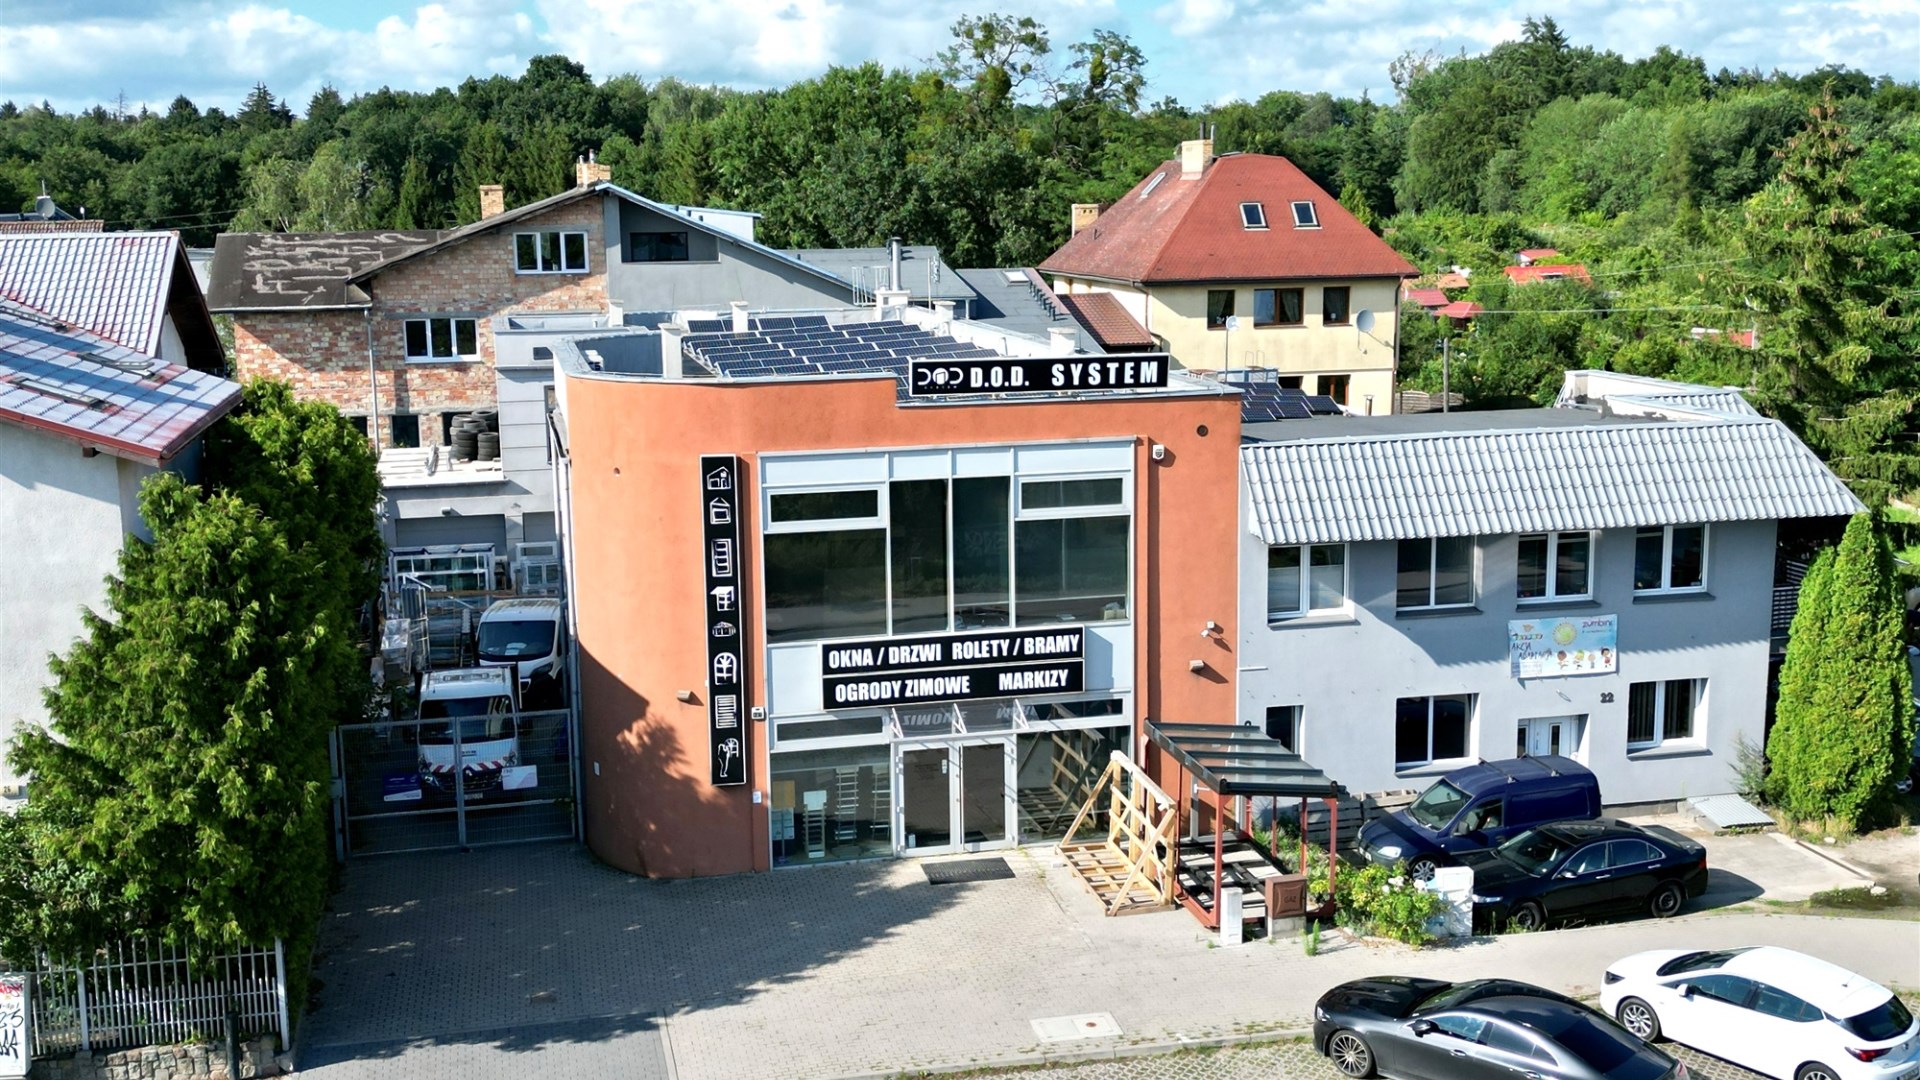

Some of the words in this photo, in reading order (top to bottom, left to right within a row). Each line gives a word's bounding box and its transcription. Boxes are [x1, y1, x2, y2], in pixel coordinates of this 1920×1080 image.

[970, 366, 1030, 388] D.O.D.
[1051, 361, 1158, 386] SYSTEM
[828, 648, 873, 669] OKNA
[888, 643, 941, 664] DRZWI
[952, 638, 1010, 660] ROLETY
[1024, 634, 1079, 655] BRAMY
[835, 680, 901, 702] OGRODY
[904, 675, 971, 697] ZIMOWE
[999, 669, 1069, 691] MARKIZY
[1600, 692, 1614, 703] 22
